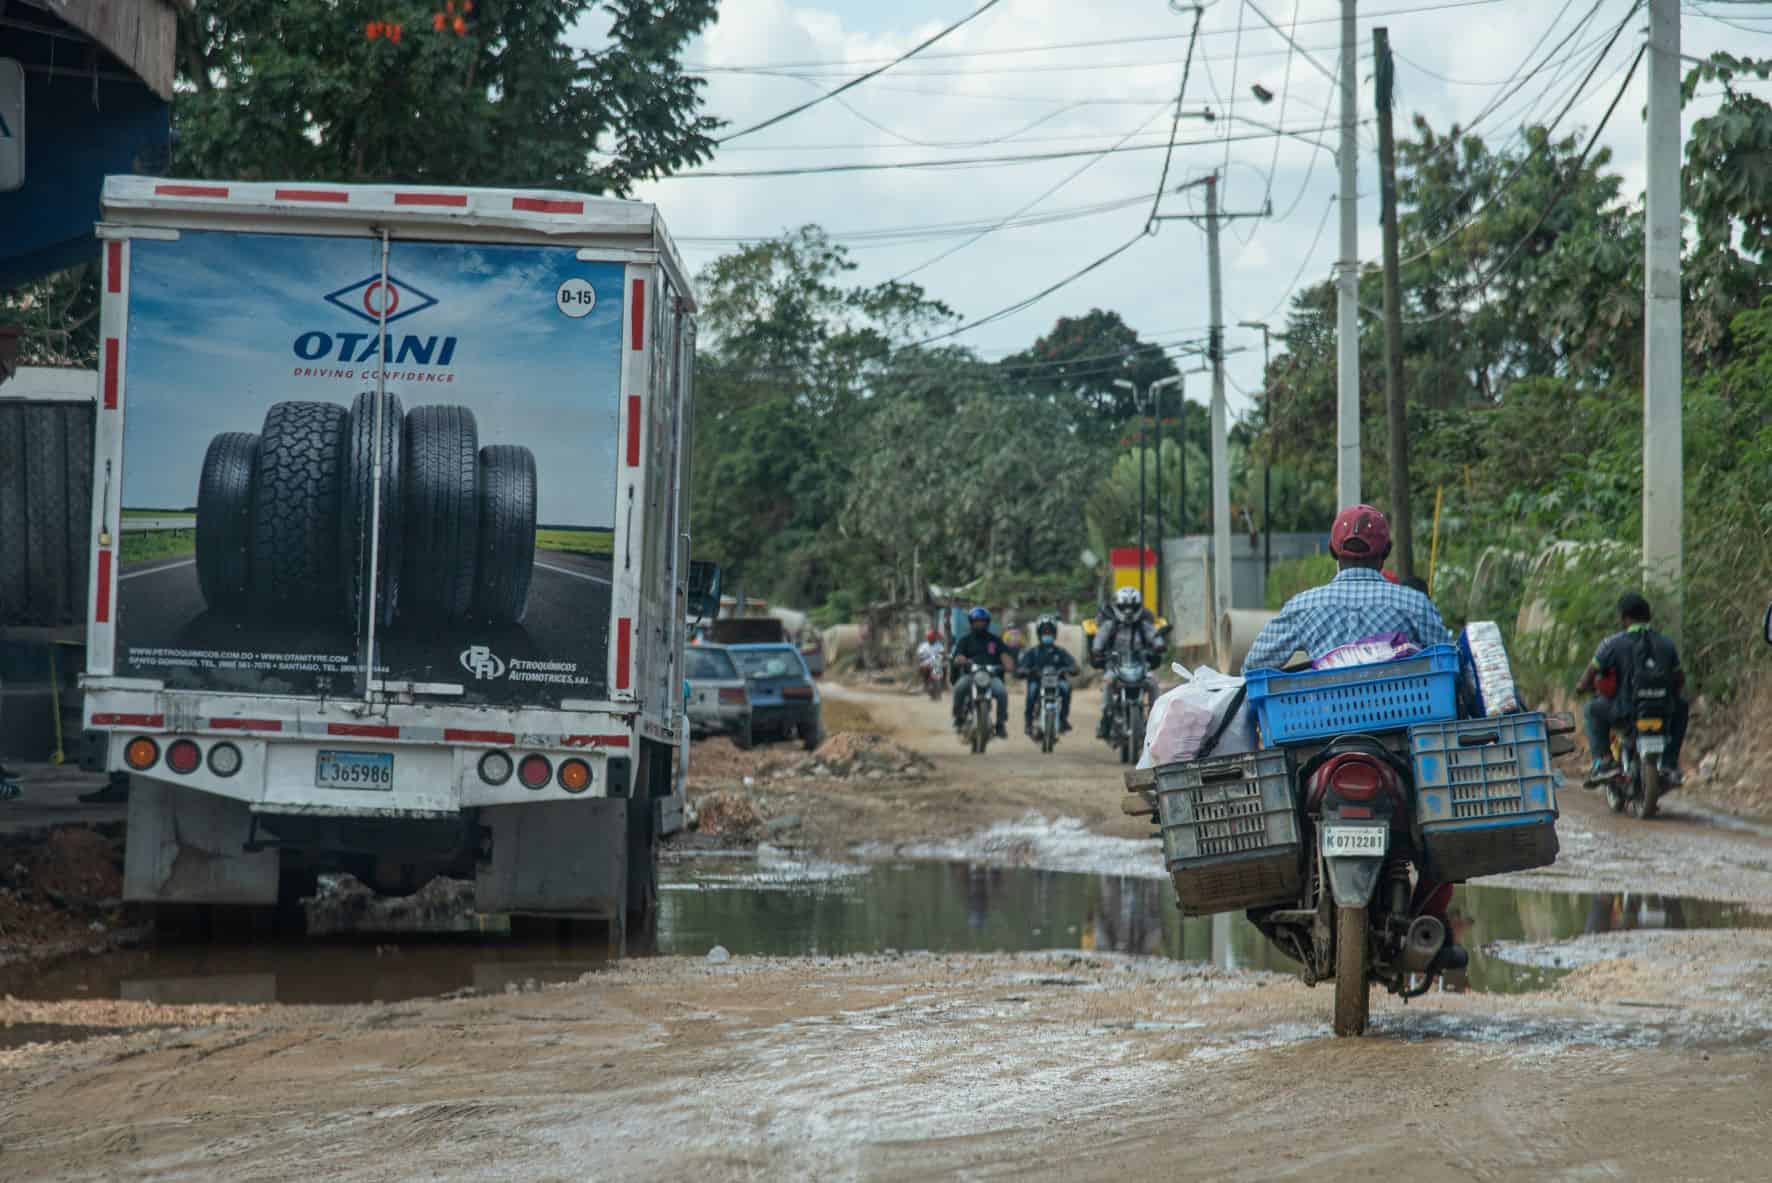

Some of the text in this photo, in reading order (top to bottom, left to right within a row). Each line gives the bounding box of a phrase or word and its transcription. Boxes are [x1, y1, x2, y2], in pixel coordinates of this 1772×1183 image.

[561, 289, 592, 305] D-15
[293, 331, 457, 365] OTANI
[293, 367, 455, 383] DRIVING CONFIDENCE
[320, 764, 390, 783] L365986
